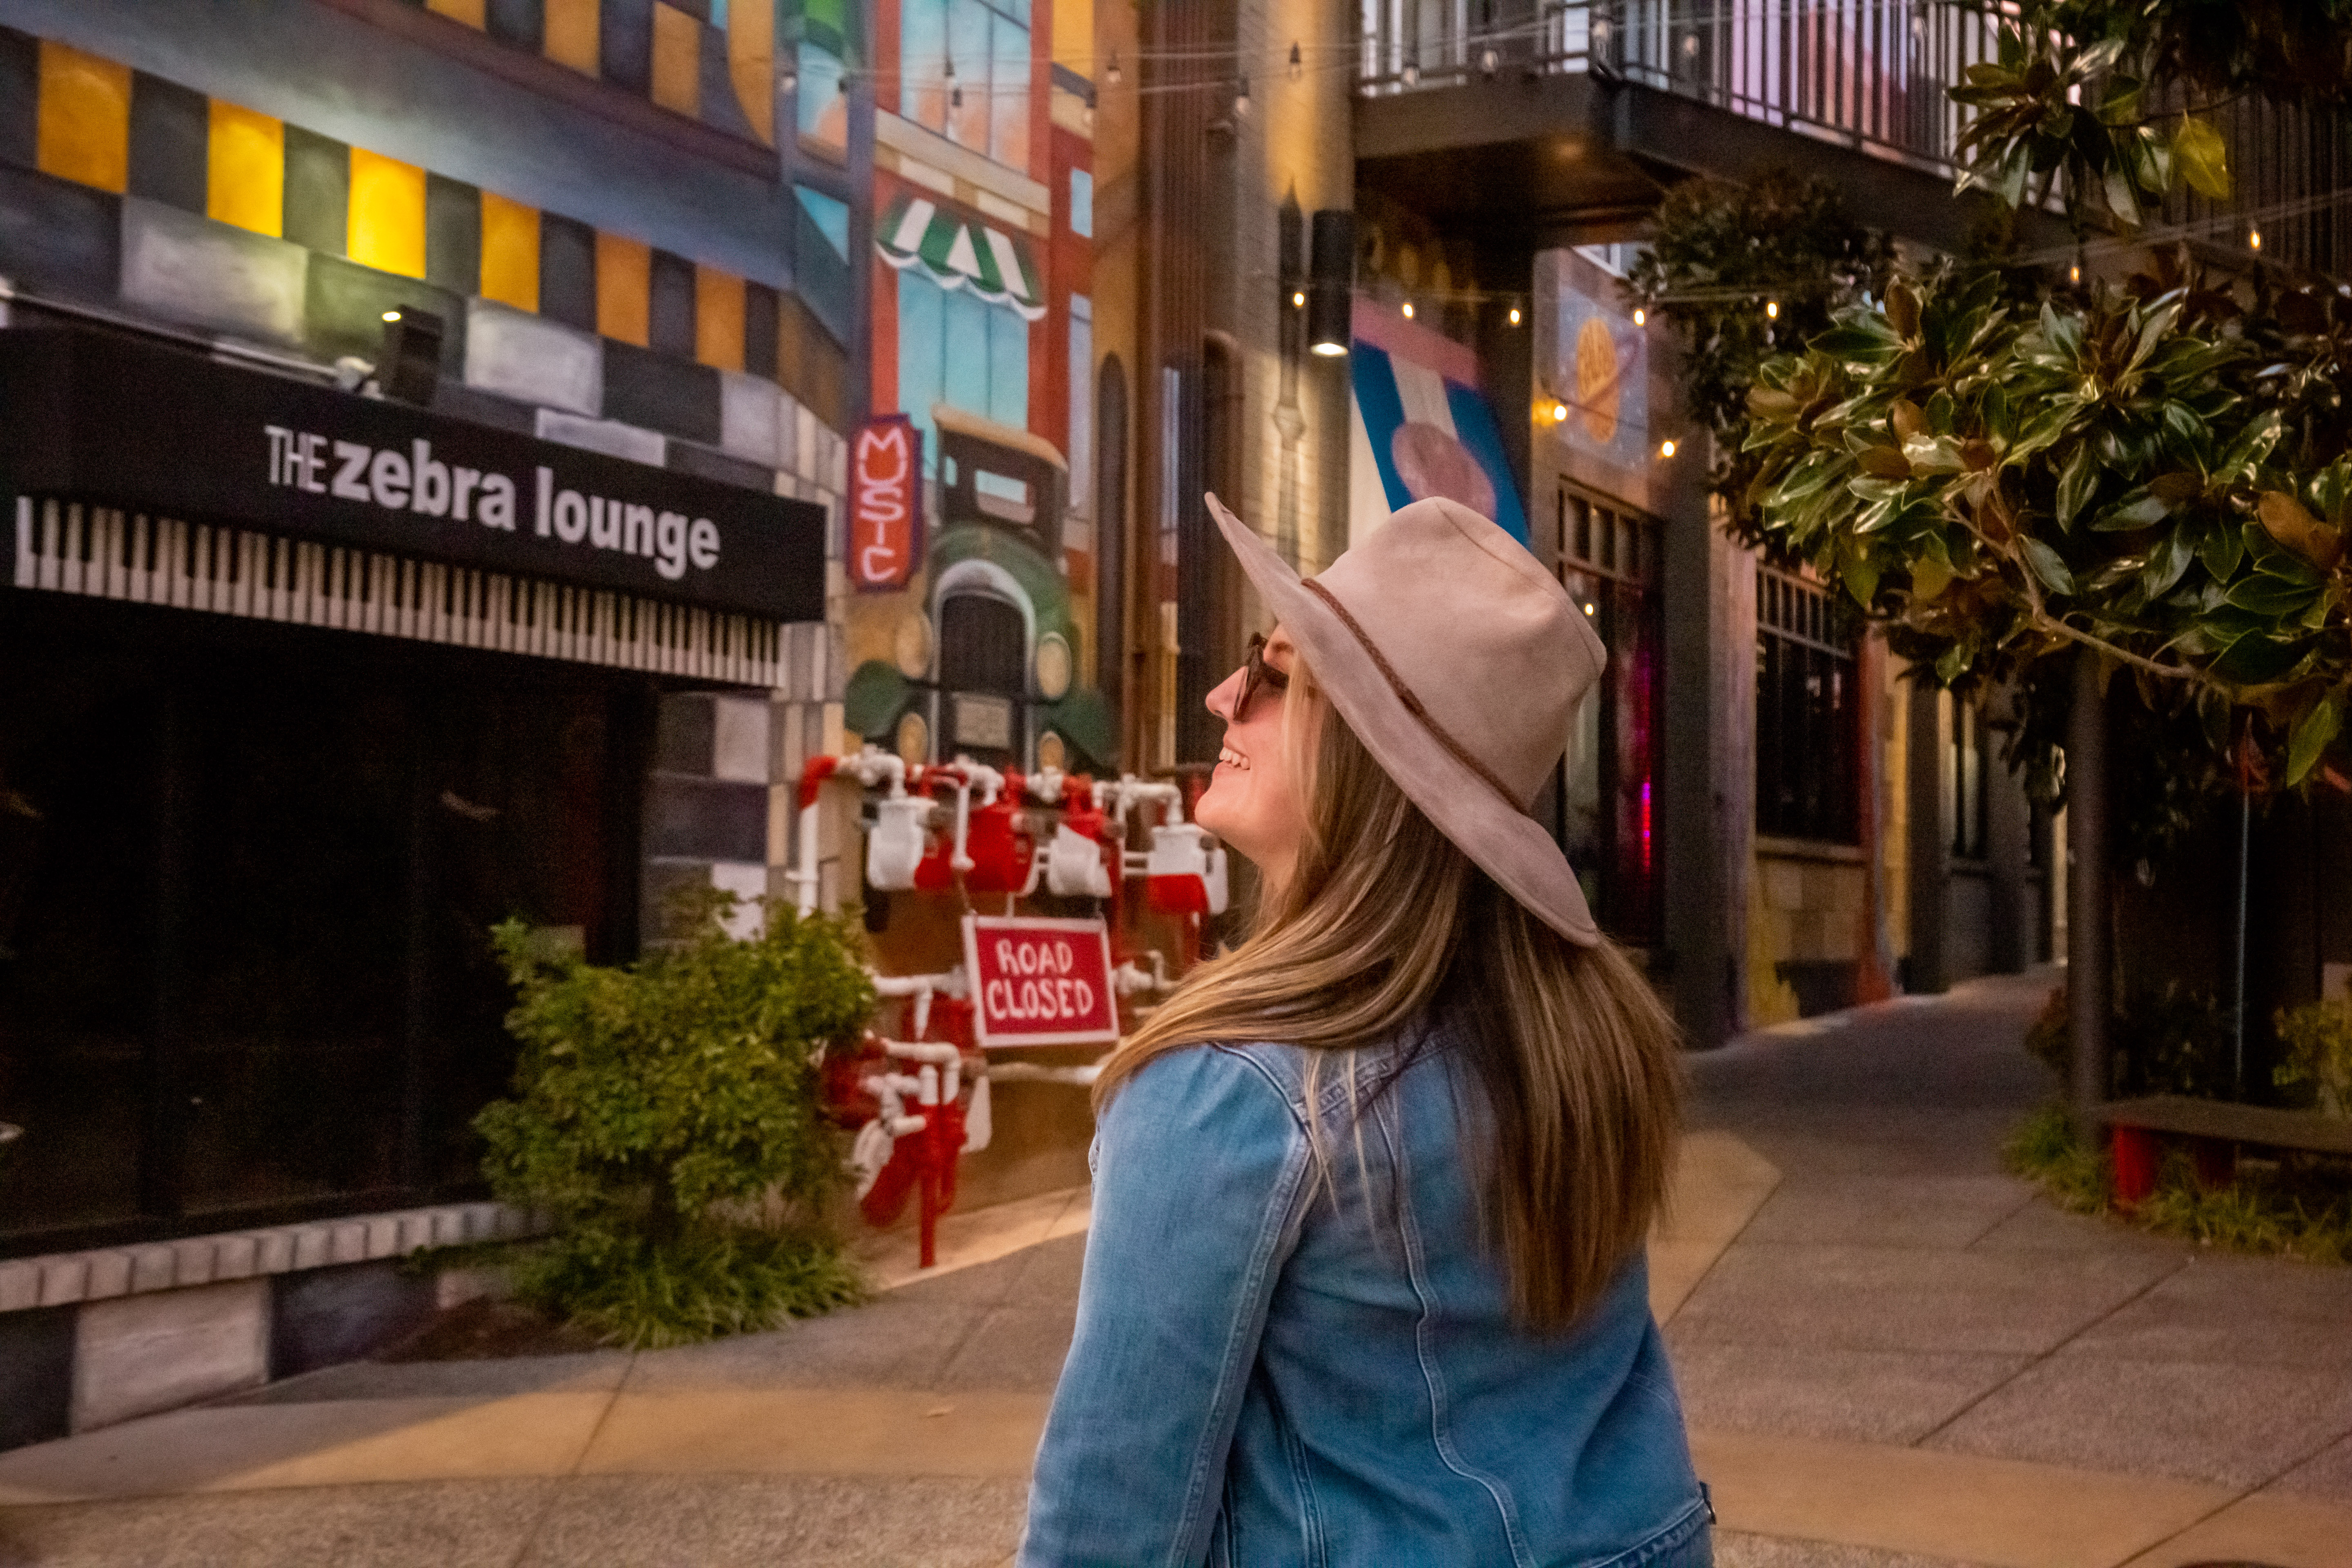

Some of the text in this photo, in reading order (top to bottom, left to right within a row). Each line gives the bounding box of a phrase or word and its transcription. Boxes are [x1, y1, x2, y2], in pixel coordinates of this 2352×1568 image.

[265, 425, 720, 580] THE zebra lounge
[859, 427, 908, 581] MUSIC
[987, 979, 1094, 1019] CLOSED
[996, 940, 1074, 975] ROAD
